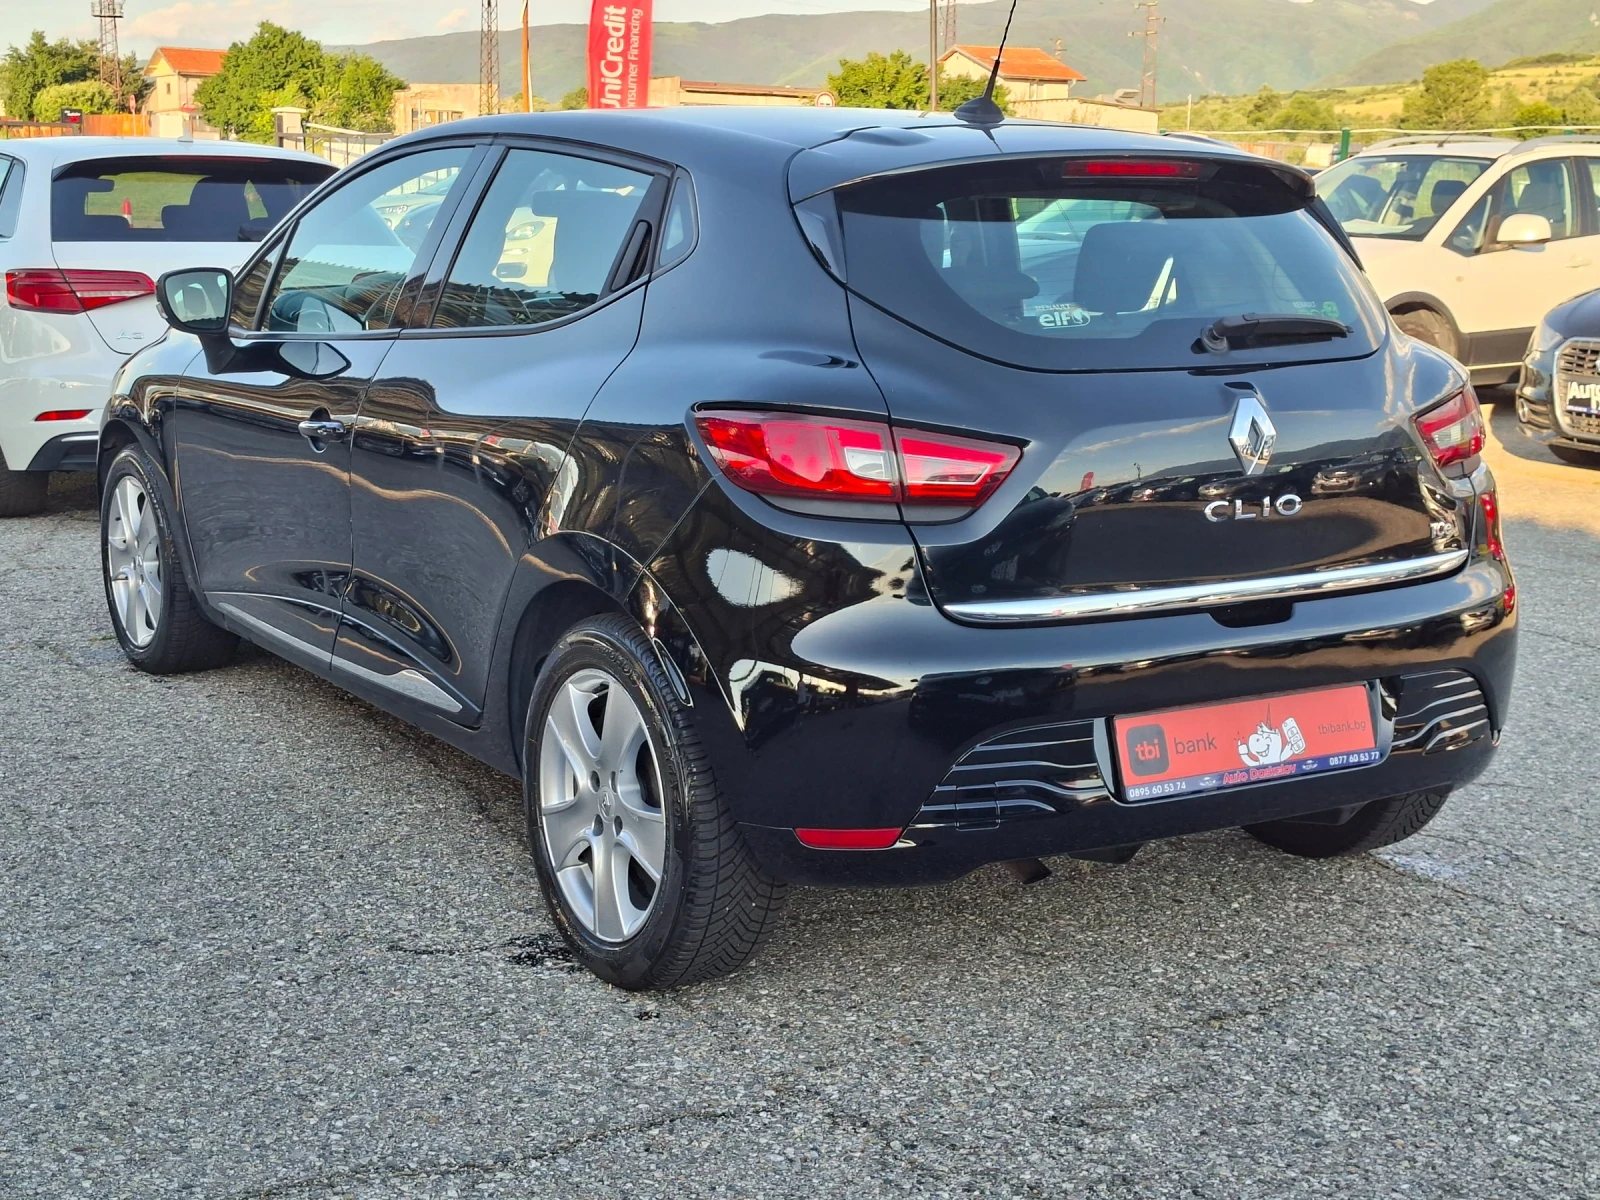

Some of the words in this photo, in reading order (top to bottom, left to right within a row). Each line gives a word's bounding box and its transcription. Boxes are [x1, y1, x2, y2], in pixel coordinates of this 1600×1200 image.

[628, 8, 643, 60] Financing
[1039, 311, 1070, 327] elf
[1204, 493, 1303, 523] CLIO
[1317, 720, 1366, 736] tbibank.bg
[1135, 738, 1161, 760] tbi
[1173, 733, 1218, 755] bank
[1329, 755, 1347, 766] 0877
[1348, 753, 1359, 763] 60
[1359, 752, 1370, 762] 53
[1370, 751, 1380, 760] 77
[1223, 771, 1248, 784] Auto
[1250, 763, 1297, 780] Daskalov
[1129, 785, 1150, 798] 0895
[1151, 784, 1163, 794] 60
[1164, 783, 1175, 793] 53
[1176, 781, 1187, 791] 74
